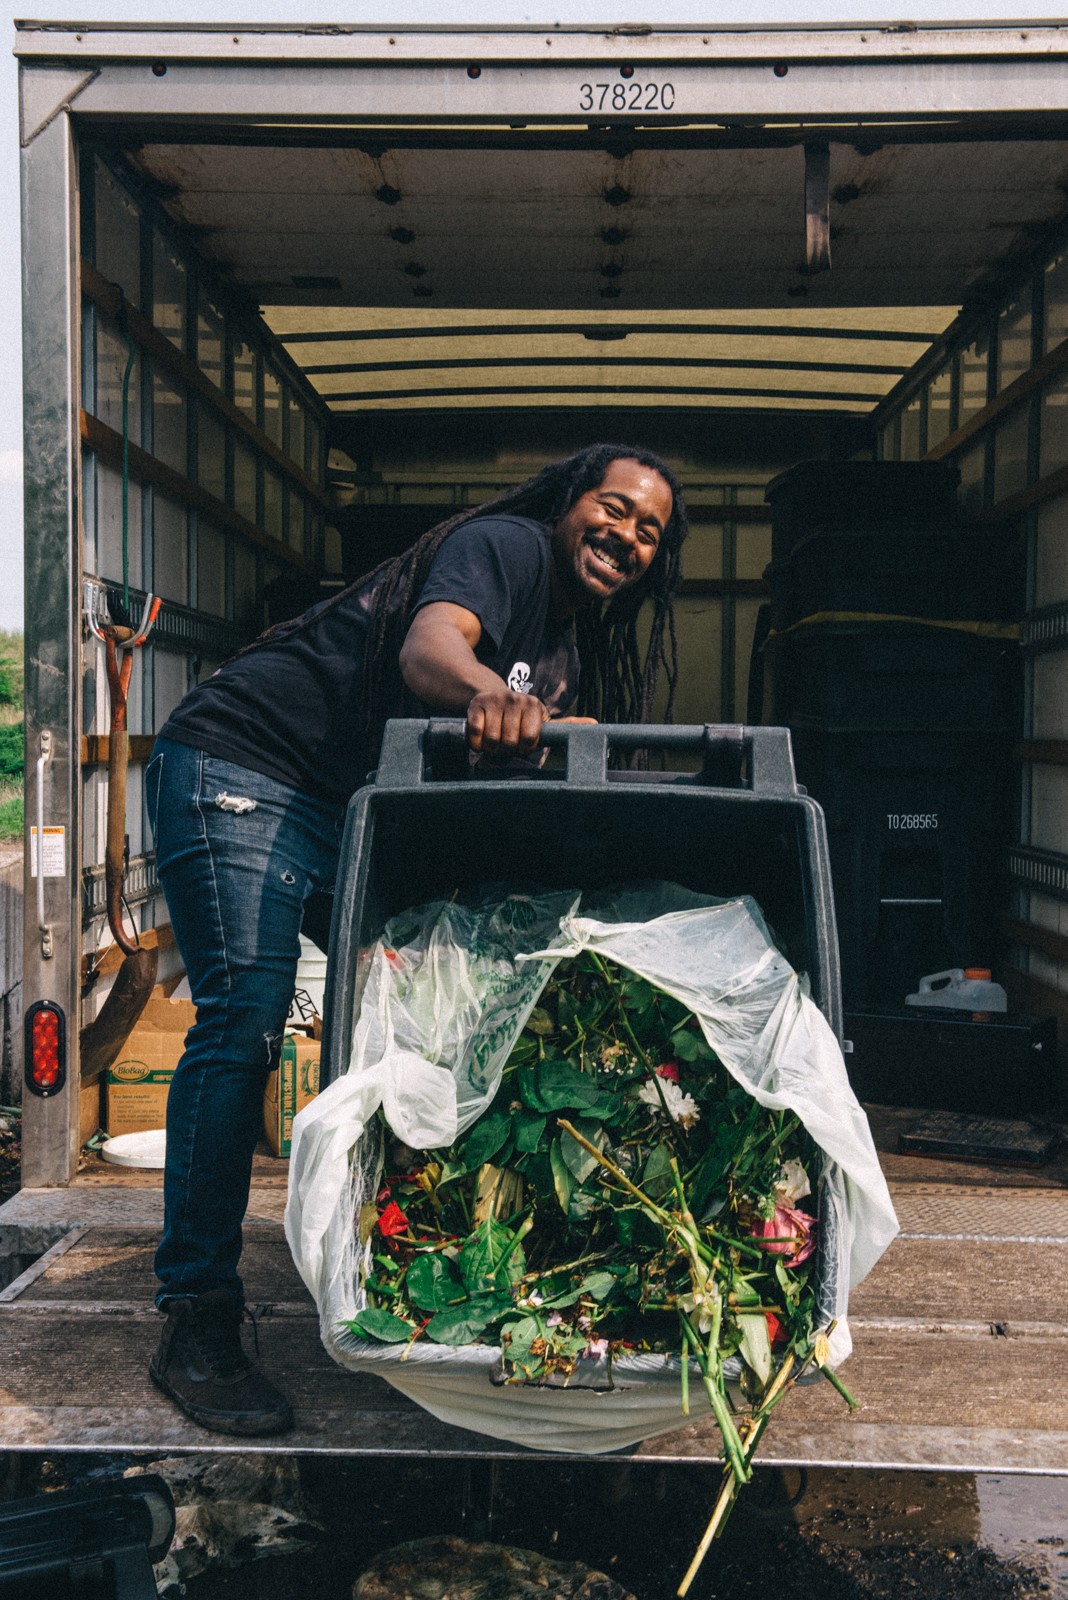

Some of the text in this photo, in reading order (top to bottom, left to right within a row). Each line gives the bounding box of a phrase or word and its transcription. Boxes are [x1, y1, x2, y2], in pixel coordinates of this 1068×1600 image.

[579, 83, 675, 110] 378220
[118, 1066, 146, 1075] BioBag
[283, 1060, 293, 1141] COMPOSTABLE LINERS
